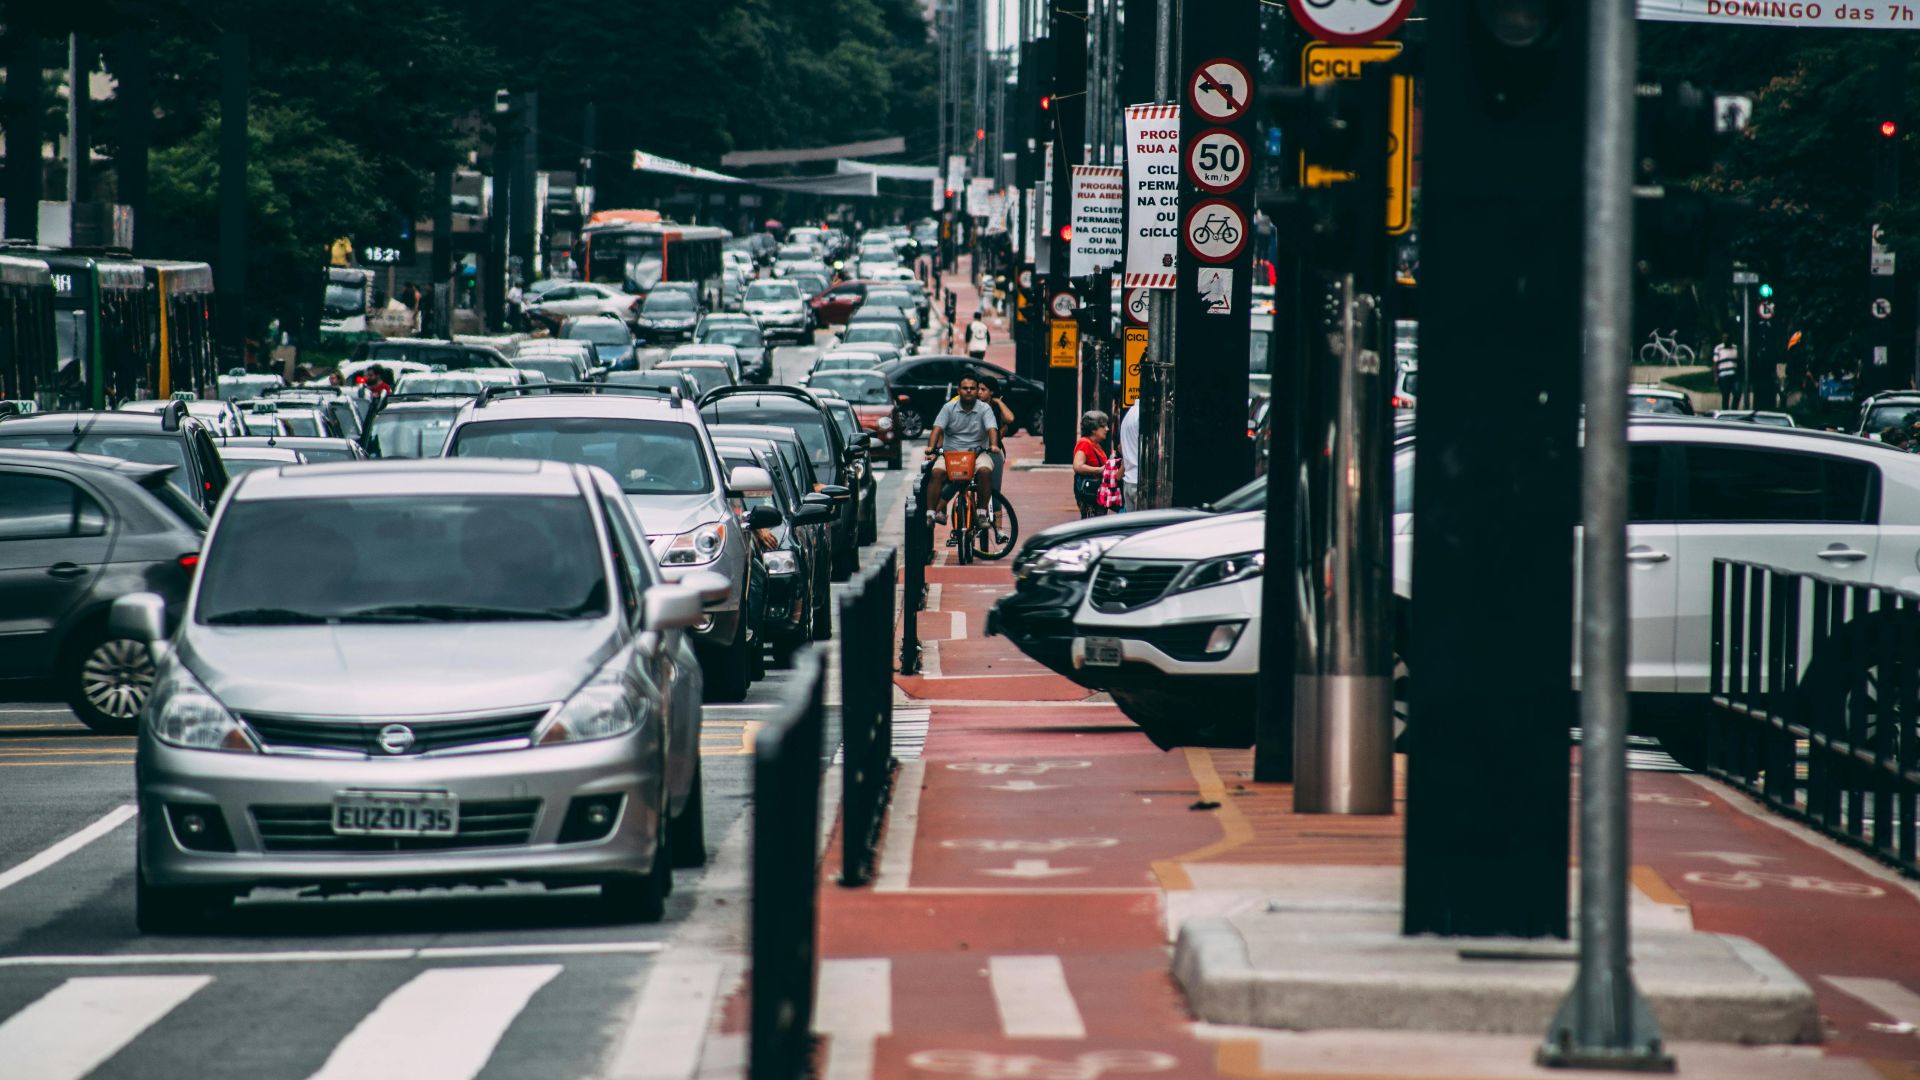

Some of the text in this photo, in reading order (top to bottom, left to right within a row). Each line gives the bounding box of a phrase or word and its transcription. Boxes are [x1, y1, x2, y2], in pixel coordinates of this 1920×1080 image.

[1708, 0, 1914, 21] DOMINGO das 7h
[1136, 144, 1165, 153] RUA
[1199, 143, 1240, 172] 50
[1204, 172, 1230, 182] km/h
[1138, 180, 1179, 190] PERM
[1137, 196, 1156, 206] NA
[1156, 212, 1176, 222] OU
